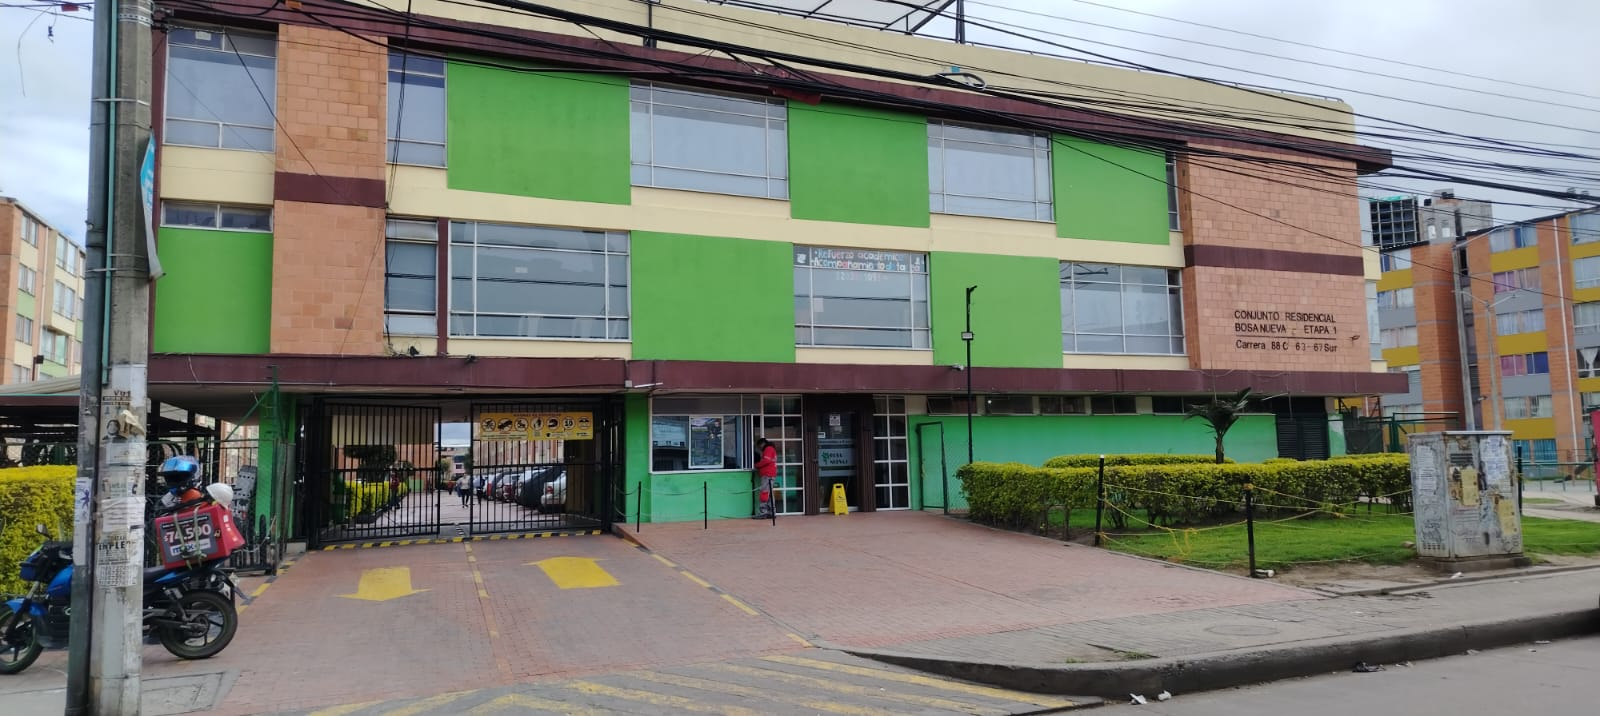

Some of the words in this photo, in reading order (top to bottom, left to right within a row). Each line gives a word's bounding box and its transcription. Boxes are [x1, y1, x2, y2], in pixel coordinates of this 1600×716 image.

[1234, 310, 1280, 321] CONJUNTO
[1285, 312, 1337, 323] RESIDENCIAL
[1235, 323, 1259, 333] BOSA
[1260, 323, 1287, 333] NUEVA
[1304, 325, 1330, 335] ETAPA
[1333, 326, 1337, 335] 1
[1236, 340, 1266, 350] Carrera
[1324, 343, 1338, 352] Sur
